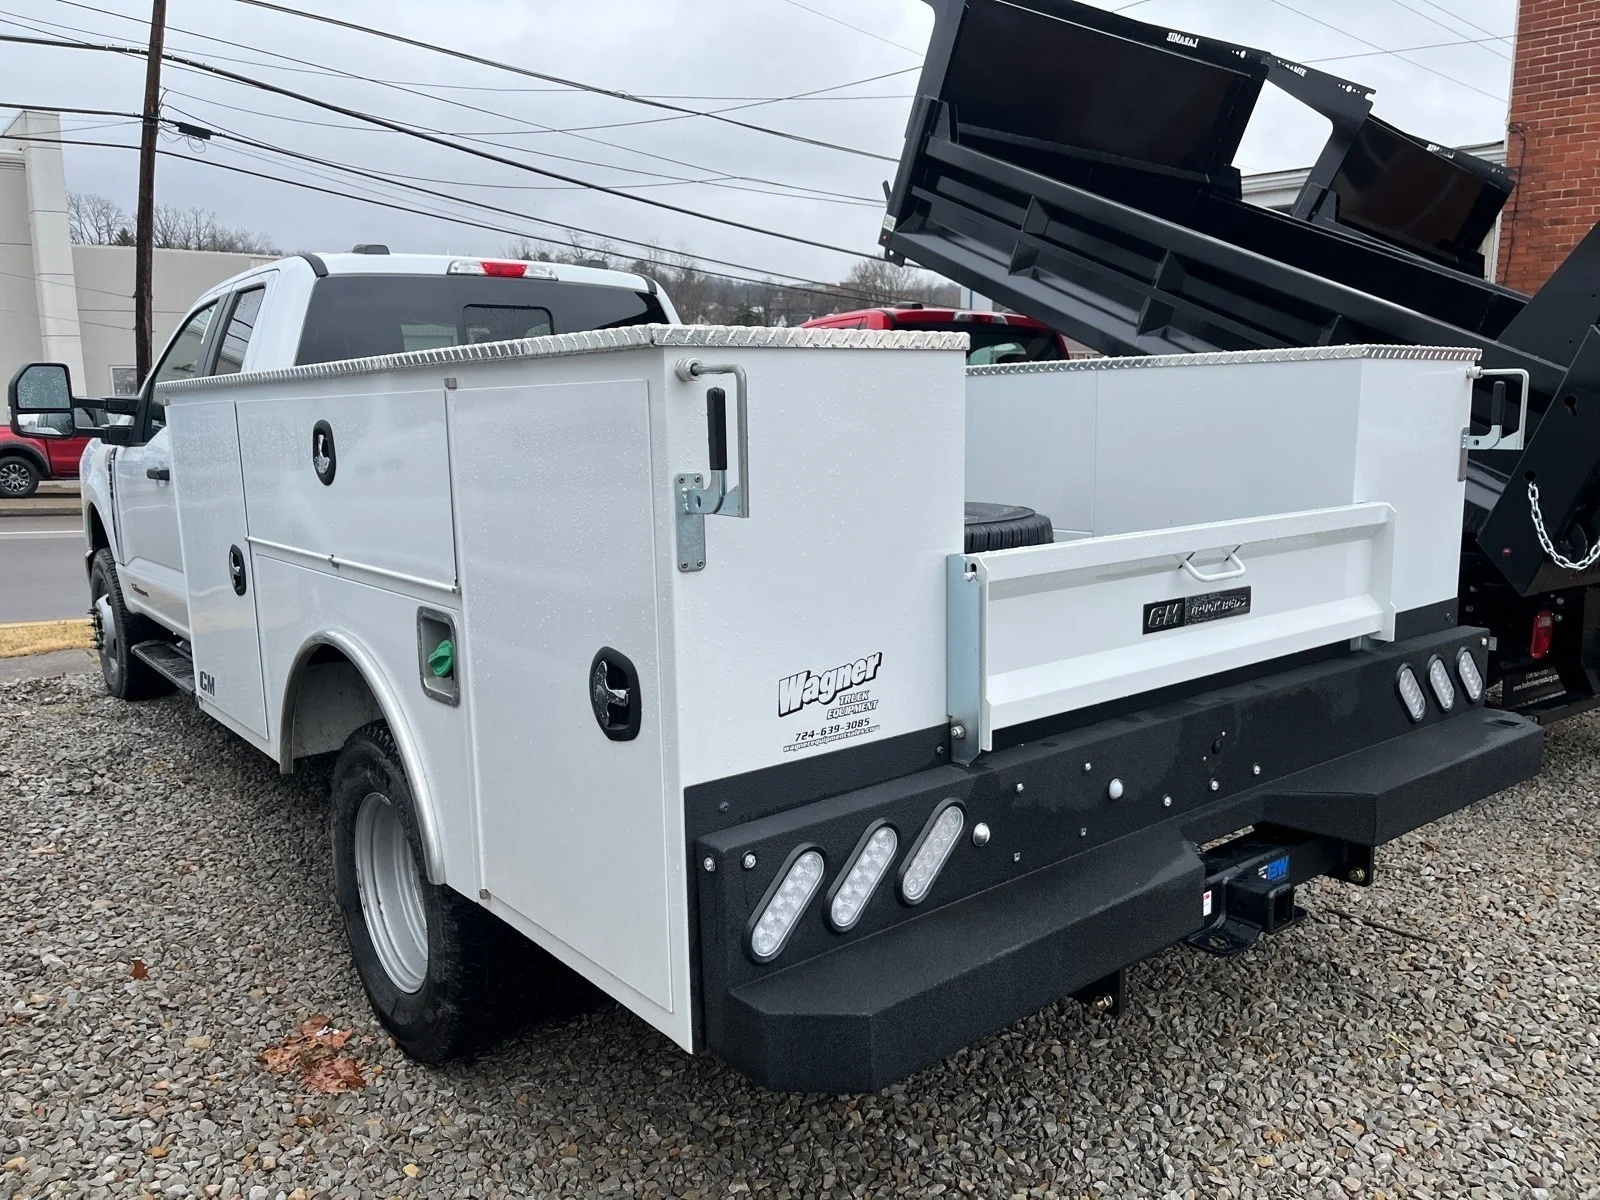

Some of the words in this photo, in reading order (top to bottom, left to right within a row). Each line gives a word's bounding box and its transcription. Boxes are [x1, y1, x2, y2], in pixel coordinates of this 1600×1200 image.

[200, 670, 216, 697] CM
[778, 651, 883, 718] Wagner
[826, 699, 879, 720] EQUIPMENT
[839, 690, 870, 706] TRUCK
[782, 724, 881, 753] wagnerequipmentsales.com
[795, 717, 871, 742] 724-639-3085
